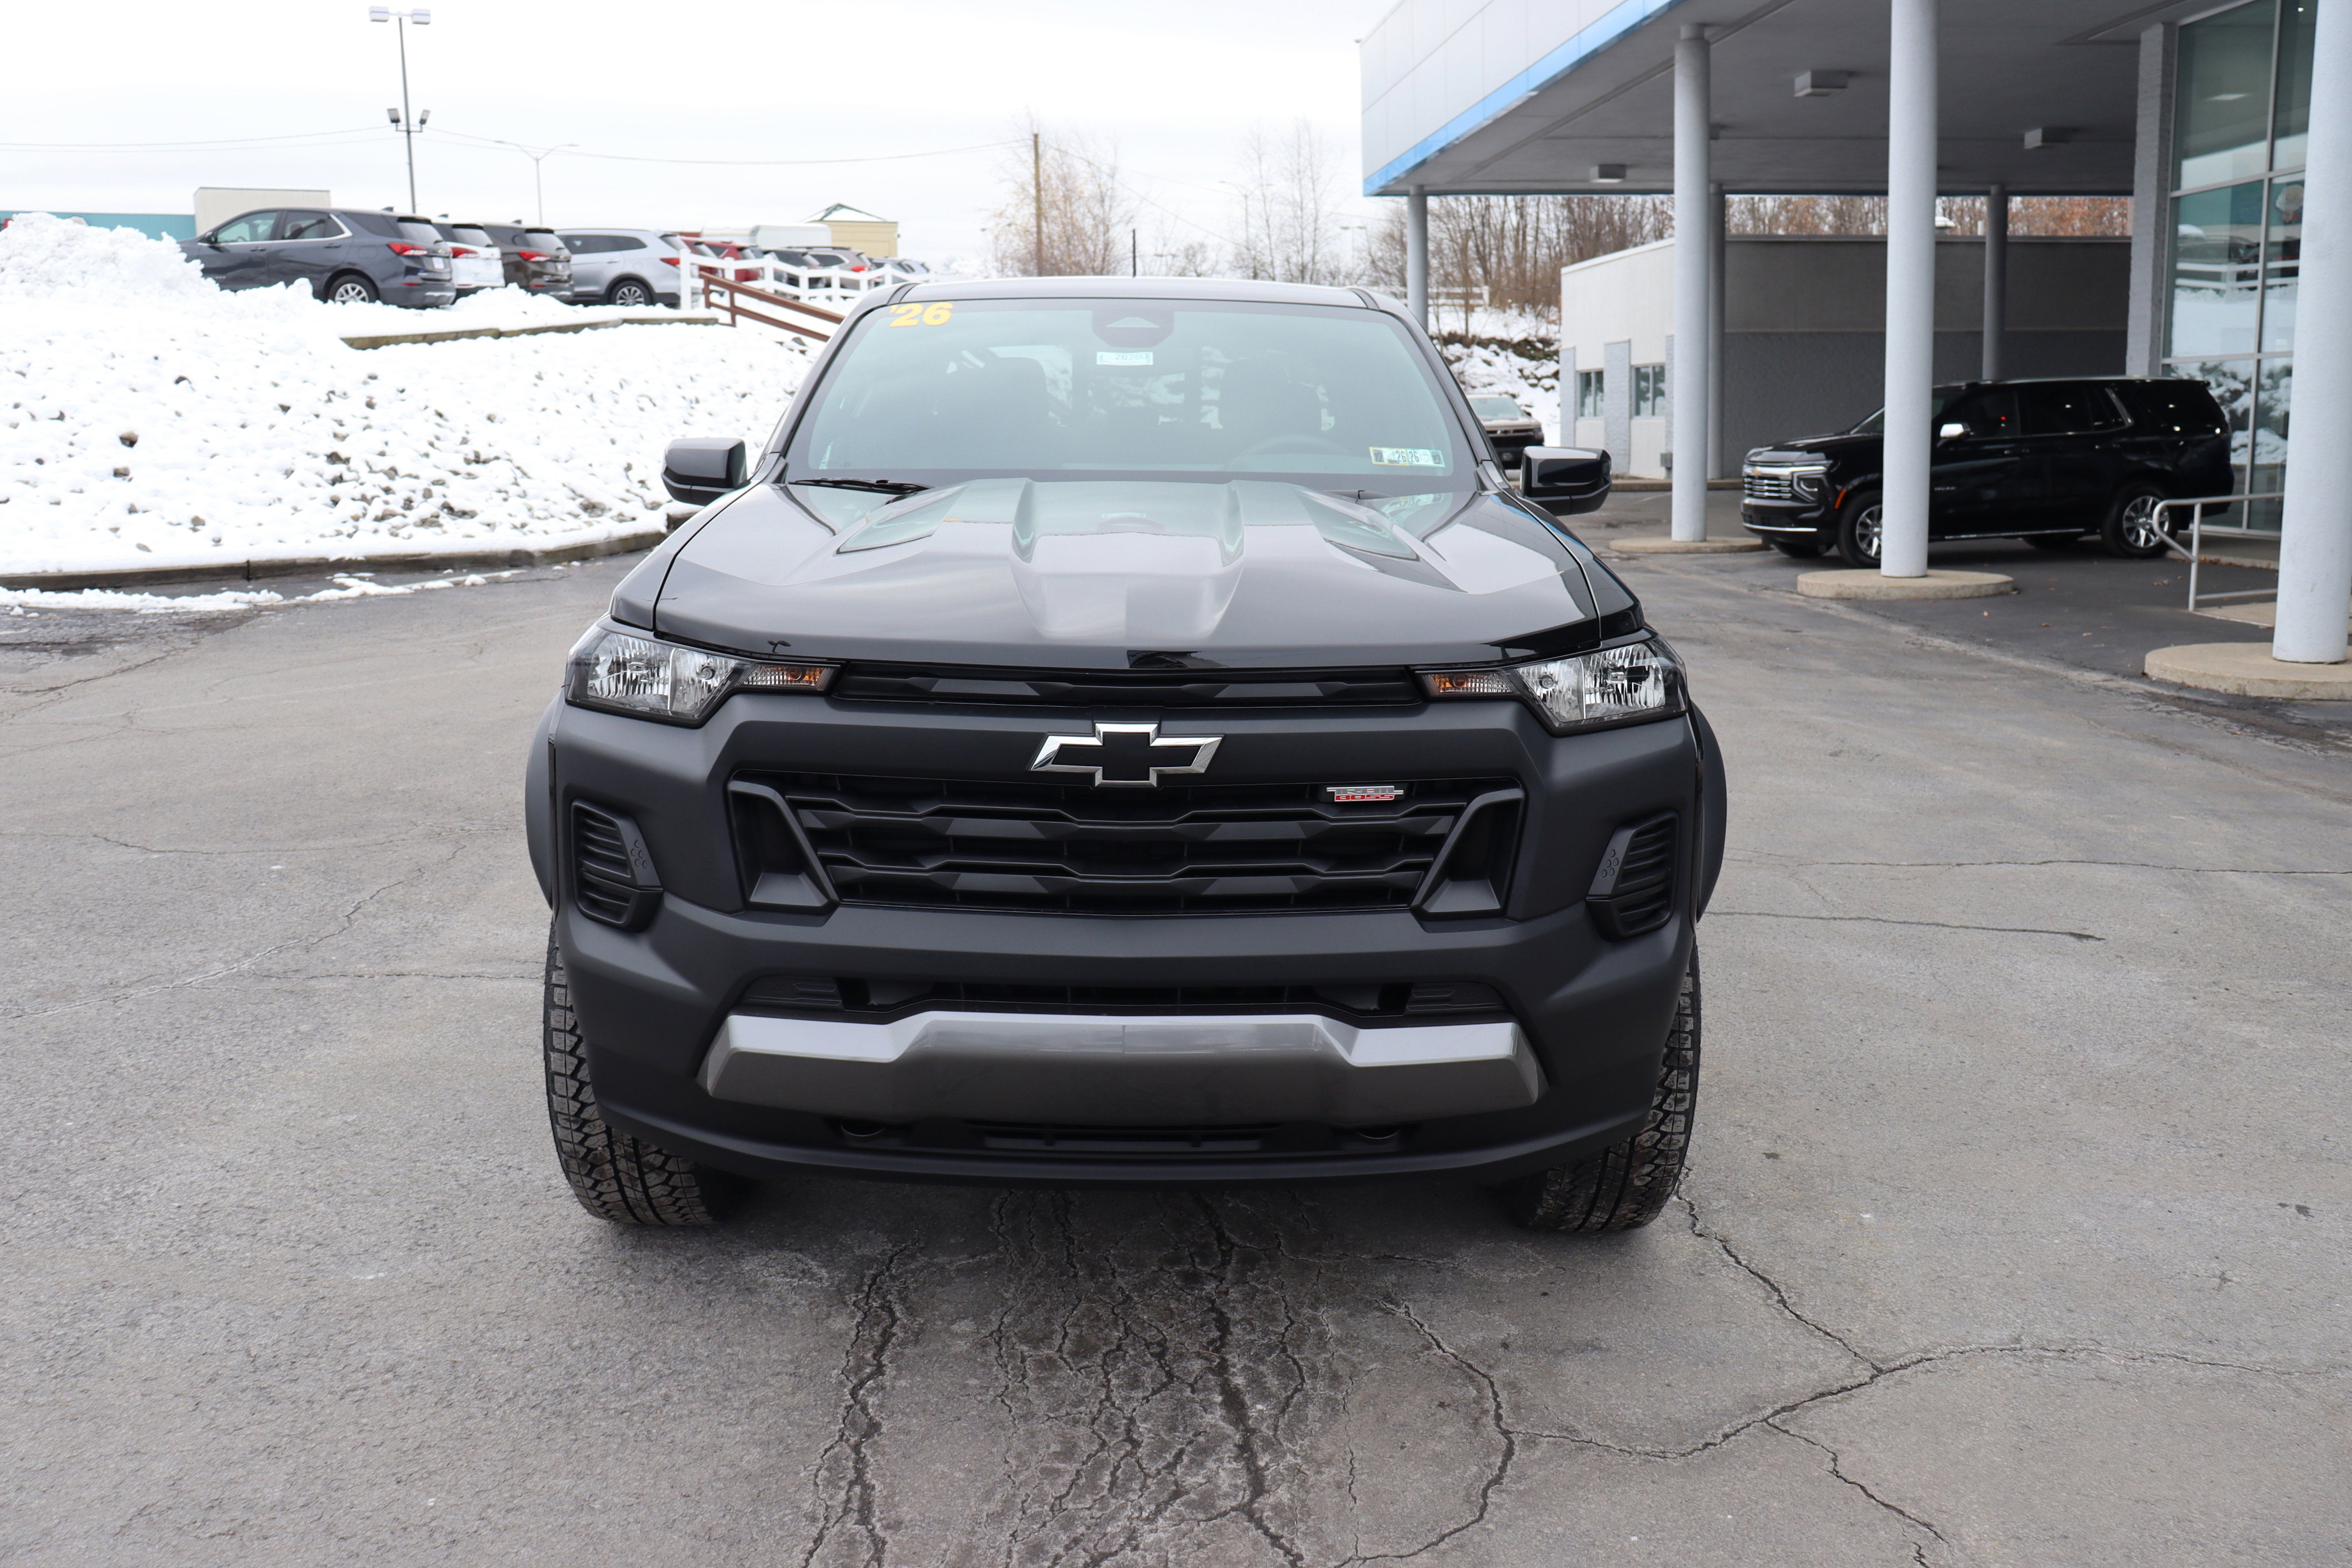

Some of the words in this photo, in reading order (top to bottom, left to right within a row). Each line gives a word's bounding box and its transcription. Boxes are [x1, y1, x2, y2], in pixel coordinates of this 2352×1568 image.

[1396, 451, 1406, 462] 26
[1409, 451, 1419, 462] 26
[1334, 794, 1394, 802] BOSS
